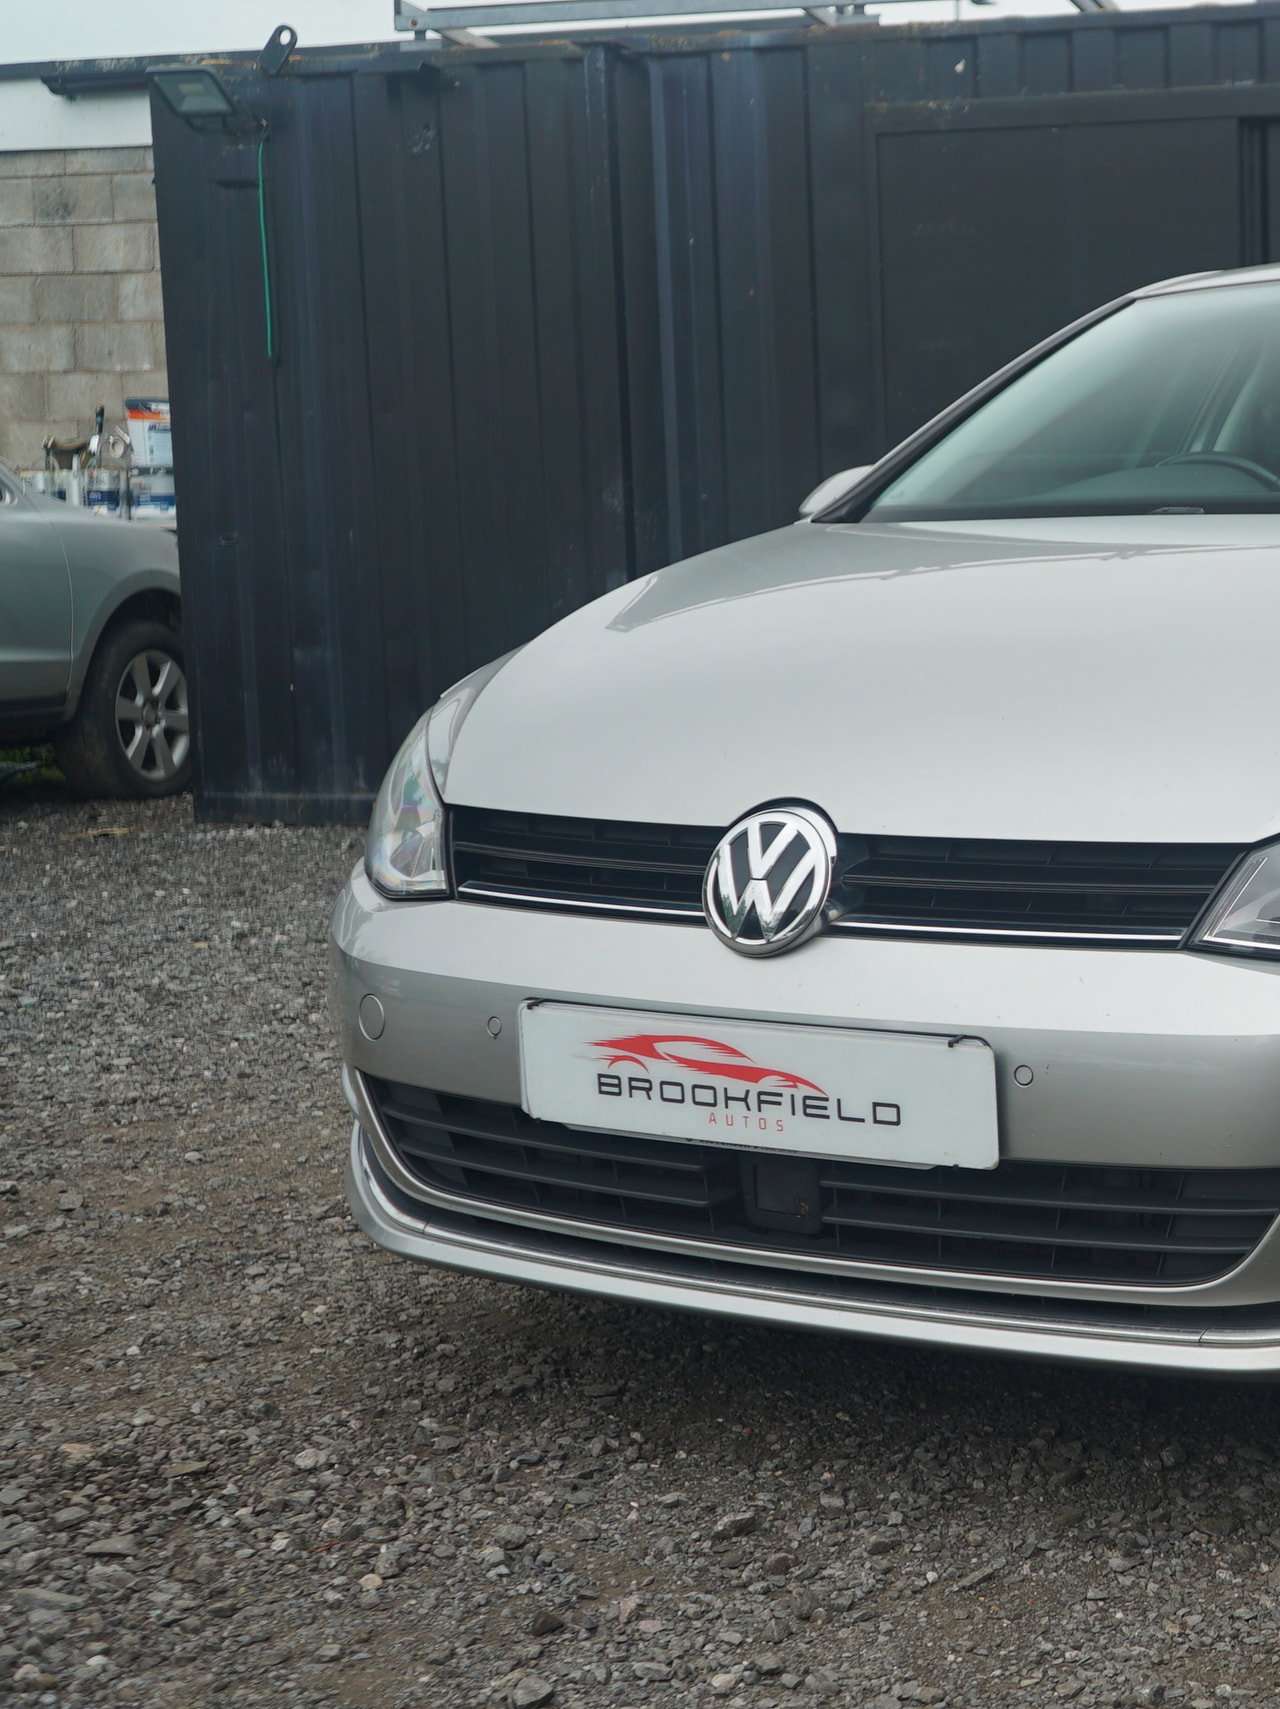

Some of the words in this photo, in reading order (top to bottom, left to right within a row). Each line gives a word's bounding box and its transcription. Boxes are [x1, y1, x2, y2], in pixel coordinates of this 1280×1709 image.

[710, 812, 825, 944] VW
[596, 1073, 902, 1126] BROOKFIELD
[708, 1112, 784, 1132] AUTOS
